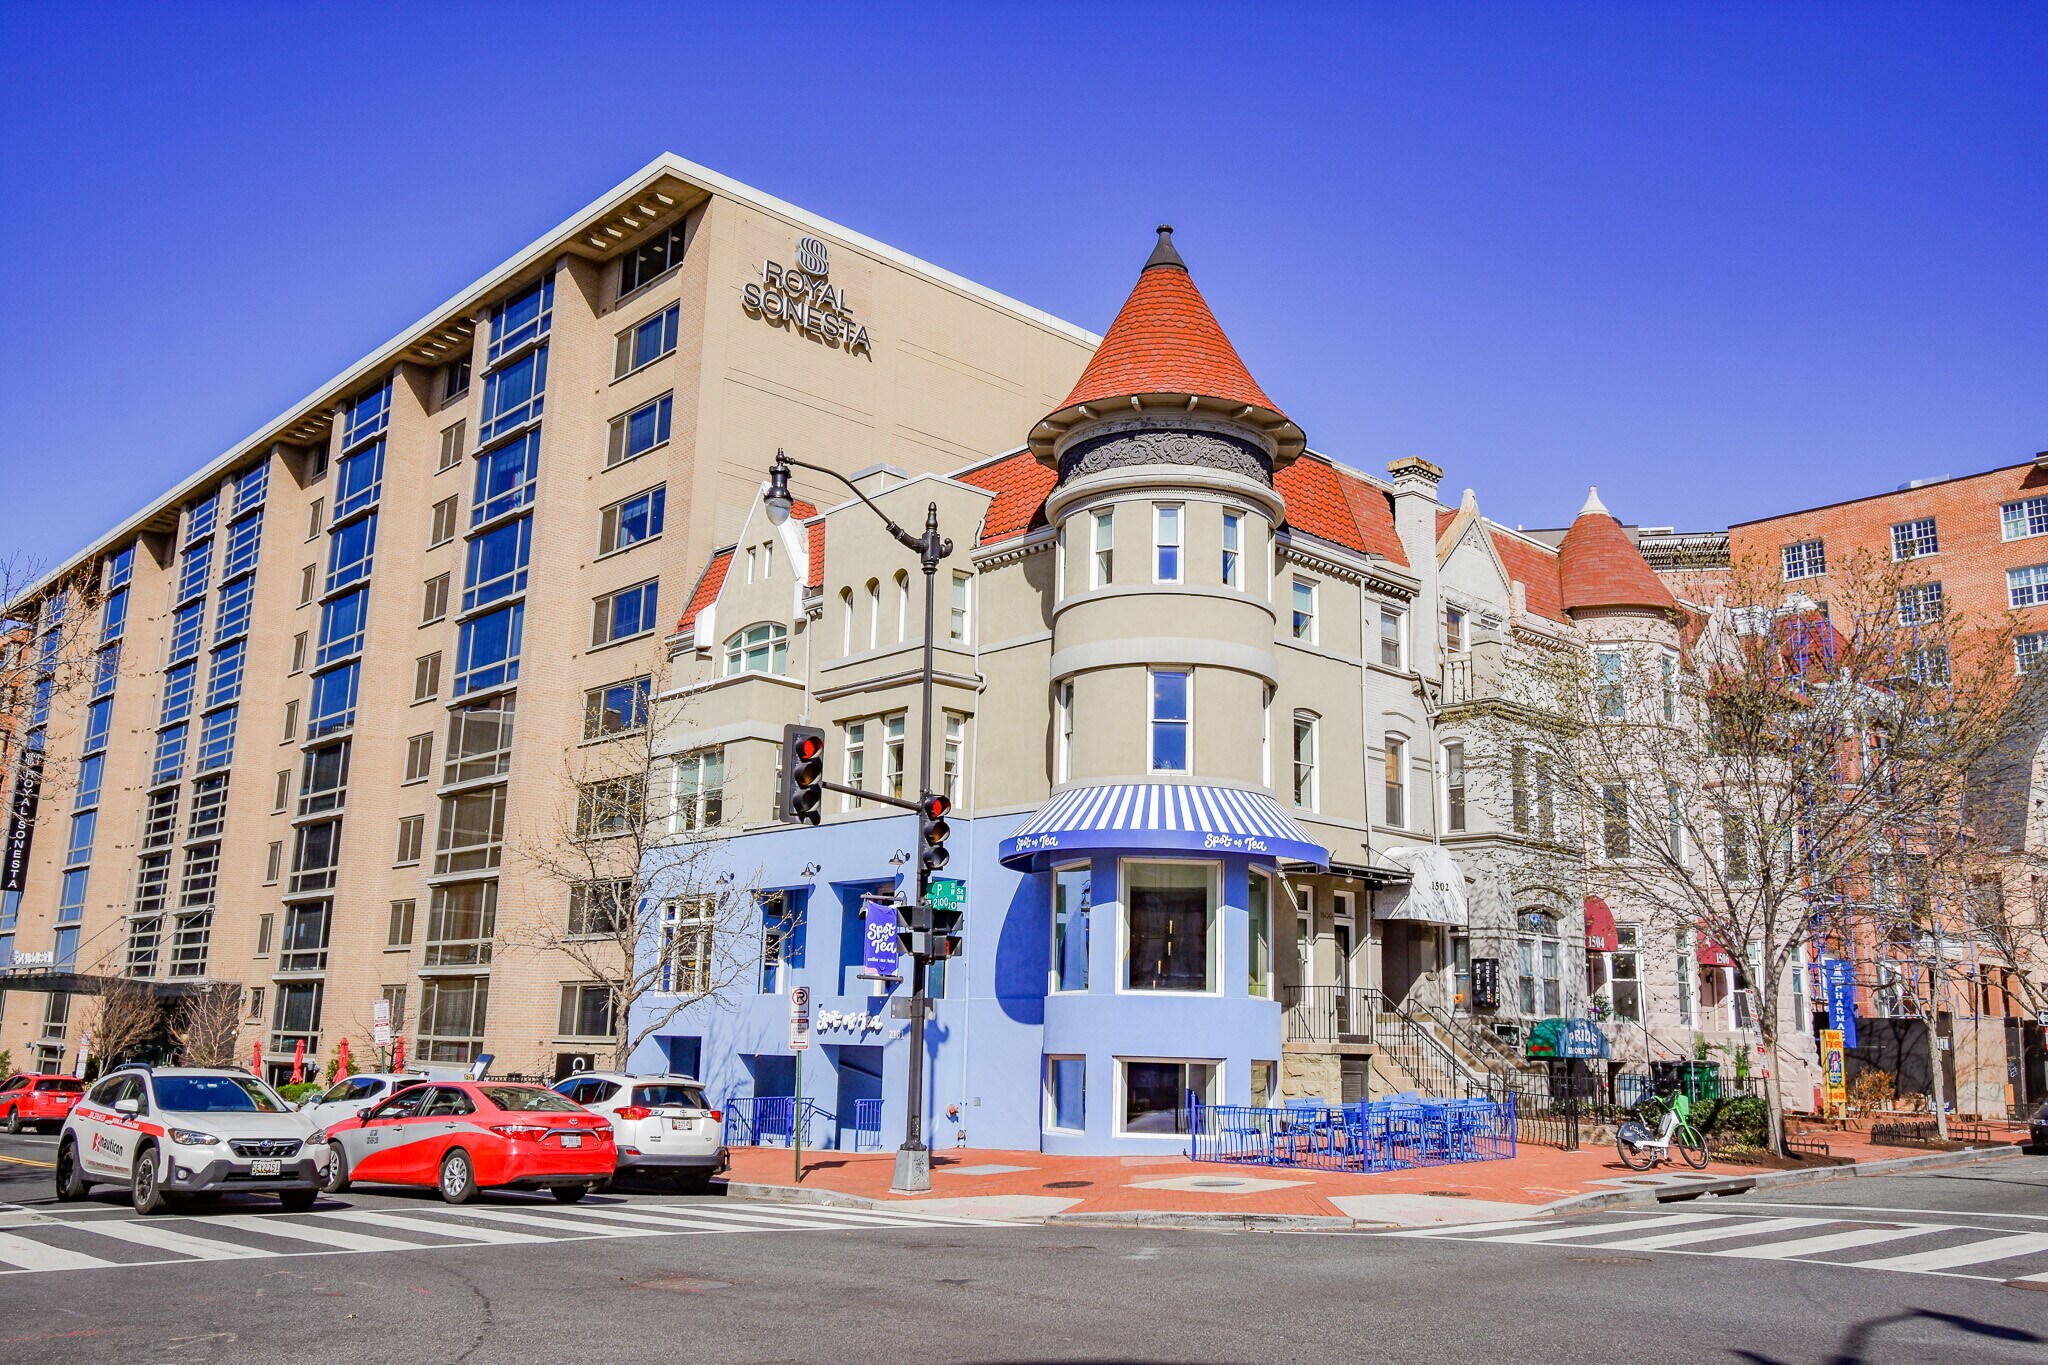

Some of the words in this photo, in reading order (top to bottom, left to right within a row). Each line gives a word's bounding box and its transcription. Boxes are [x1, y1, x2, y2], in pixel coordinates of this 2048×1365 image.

[763, 260, 853, 314] ROYAL
[742, 283, 871, 350] SONESTA
[21, 770, 36, 816] ROYAL
[1016, 837, 1032, 852] Spot
[1032, 838, 1039, 848] of
[1040, 834, 1059, 849] Tea
[1204, 833, 1233, 848] Spot
[1234, 839, 1243, 848] of
[1244, 837, 1267, 851] Tea
[7, 820, 26, 888] SONESTA
[936, 884, 943, 896] P
[1432, 881, 1449, 891] 1502
[933, 897, 949, 907] 2100
[867, 922, 896, 940] Spot
[881, 933, 889, 942] of
[871, 938, 897, 954] Tea
[1588, 936, 1605, 948] 1504
[816, 1010, 842, 1030] Spot
[858, 1010, 883, 1031] Tea
[888, 1030, 905, 1040] 2101
[1568, 1029, 1598, 1046] PRIDE
[100, 1137, 124, 1156] nauticon
